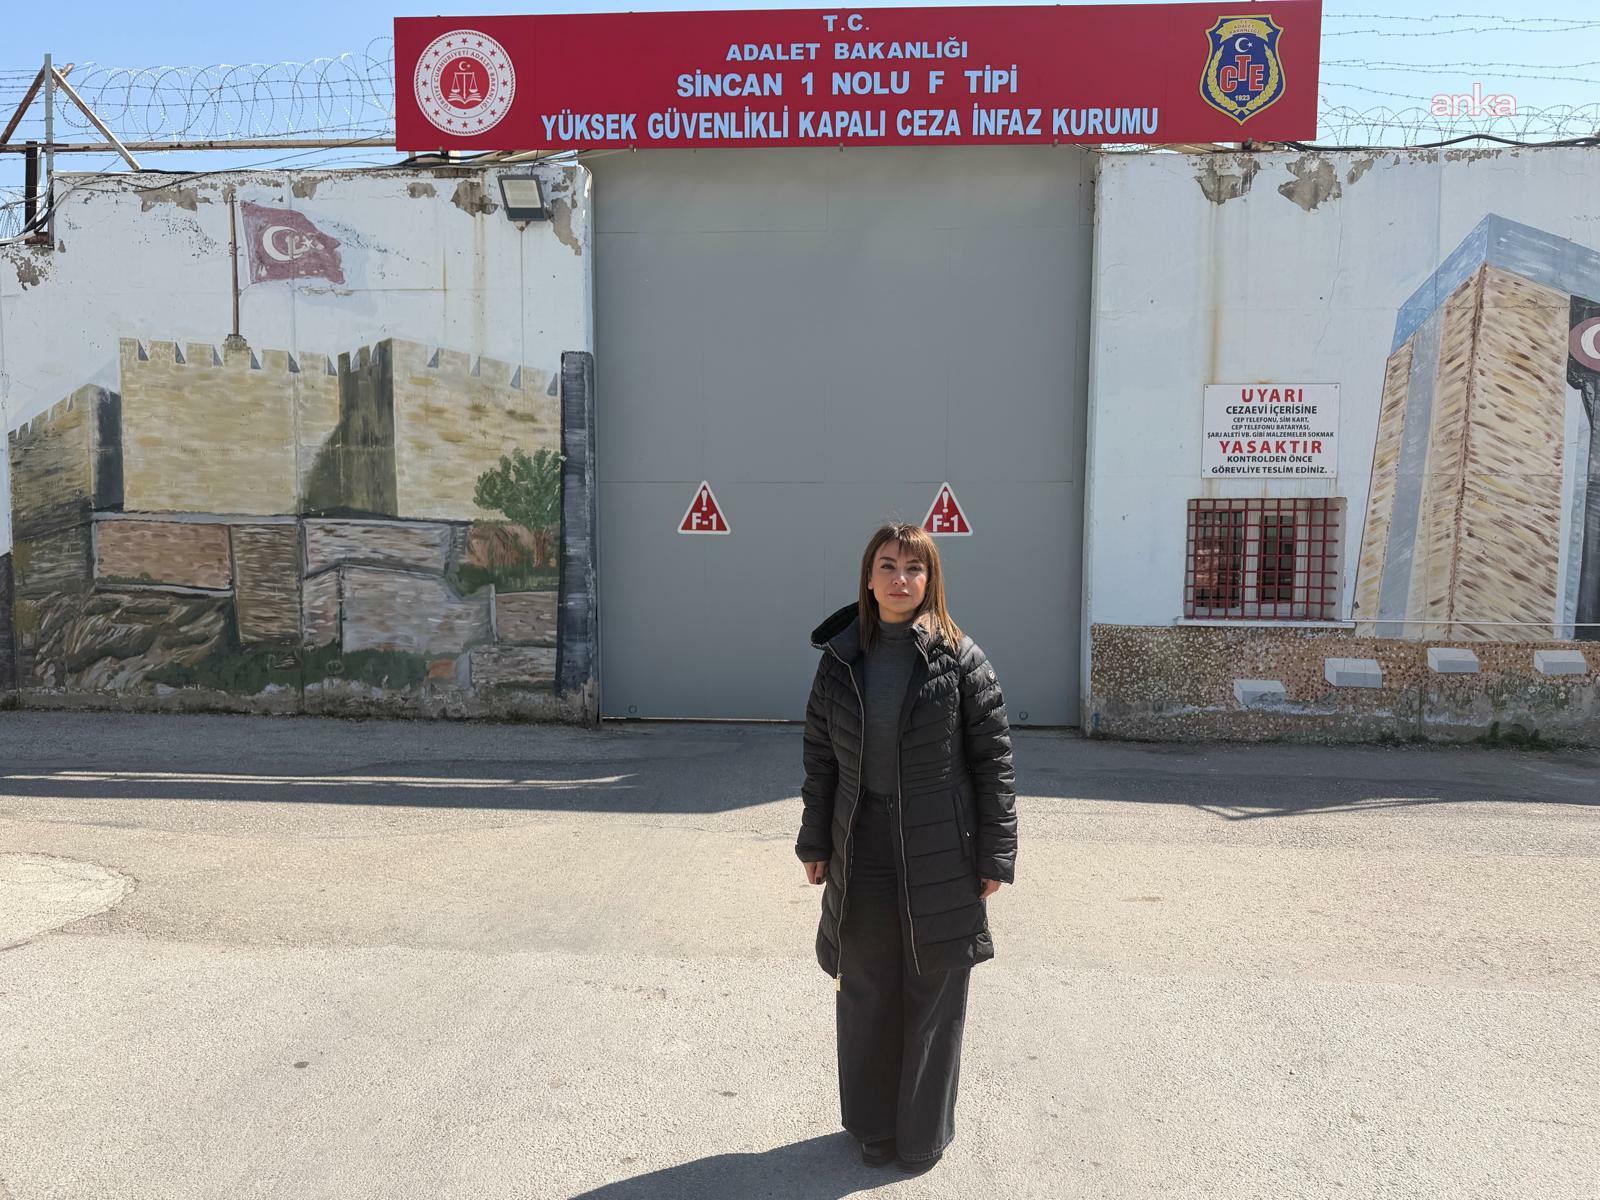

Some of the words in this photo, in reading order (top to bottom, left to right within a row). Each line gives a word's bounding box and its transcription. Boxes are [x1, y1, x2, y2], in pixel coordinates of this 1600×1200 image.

[823, 13, 870, 32] T.C.
[726, 42, 820, 61] ADALET
[834, 36, 968, 60] BAKANLIĞI
[470, 50, 493, 71] ADALET
[677, 69, 782, 97] SİNCAN
[801, 72, 813, 95] 1
[832, 70, 910, 95] NOLU
[929, 71, 944, 94] F
[964, 64, 1017, 93] TİPİ
[1220, 55, 1264, 93] CTE
[541, 109, 637, 141] YÜKSEK
[647, 105, 788, 140] GÜVENLİKLİ
[799, 110, 886, 138] KAPALI
[896, 109, 961, 136] CEZA
[972, 103, 1042, 135] İNFAZ
[1052, 107, 1158, 135] KURUMU
[1241, 388, 1303, 403] UYARI
[1225, 404, 1268, 415] CEZAEVİ
[1269, 403, 1318, 416] İÇERİSİNE
[1219, 440, 1322, 454] YASAKTIR
[1288, 454, 1312, 463] ÖNCE
[1212, 465, 1260, 474] GÖREVLİYE
[1262, 465, 1294, 474] TESLİM
[1295, 465, 1328, 474] EDİNİZ.
[691, 512, 717, 530] F-1
[932, 514, 959, 532] F-1
